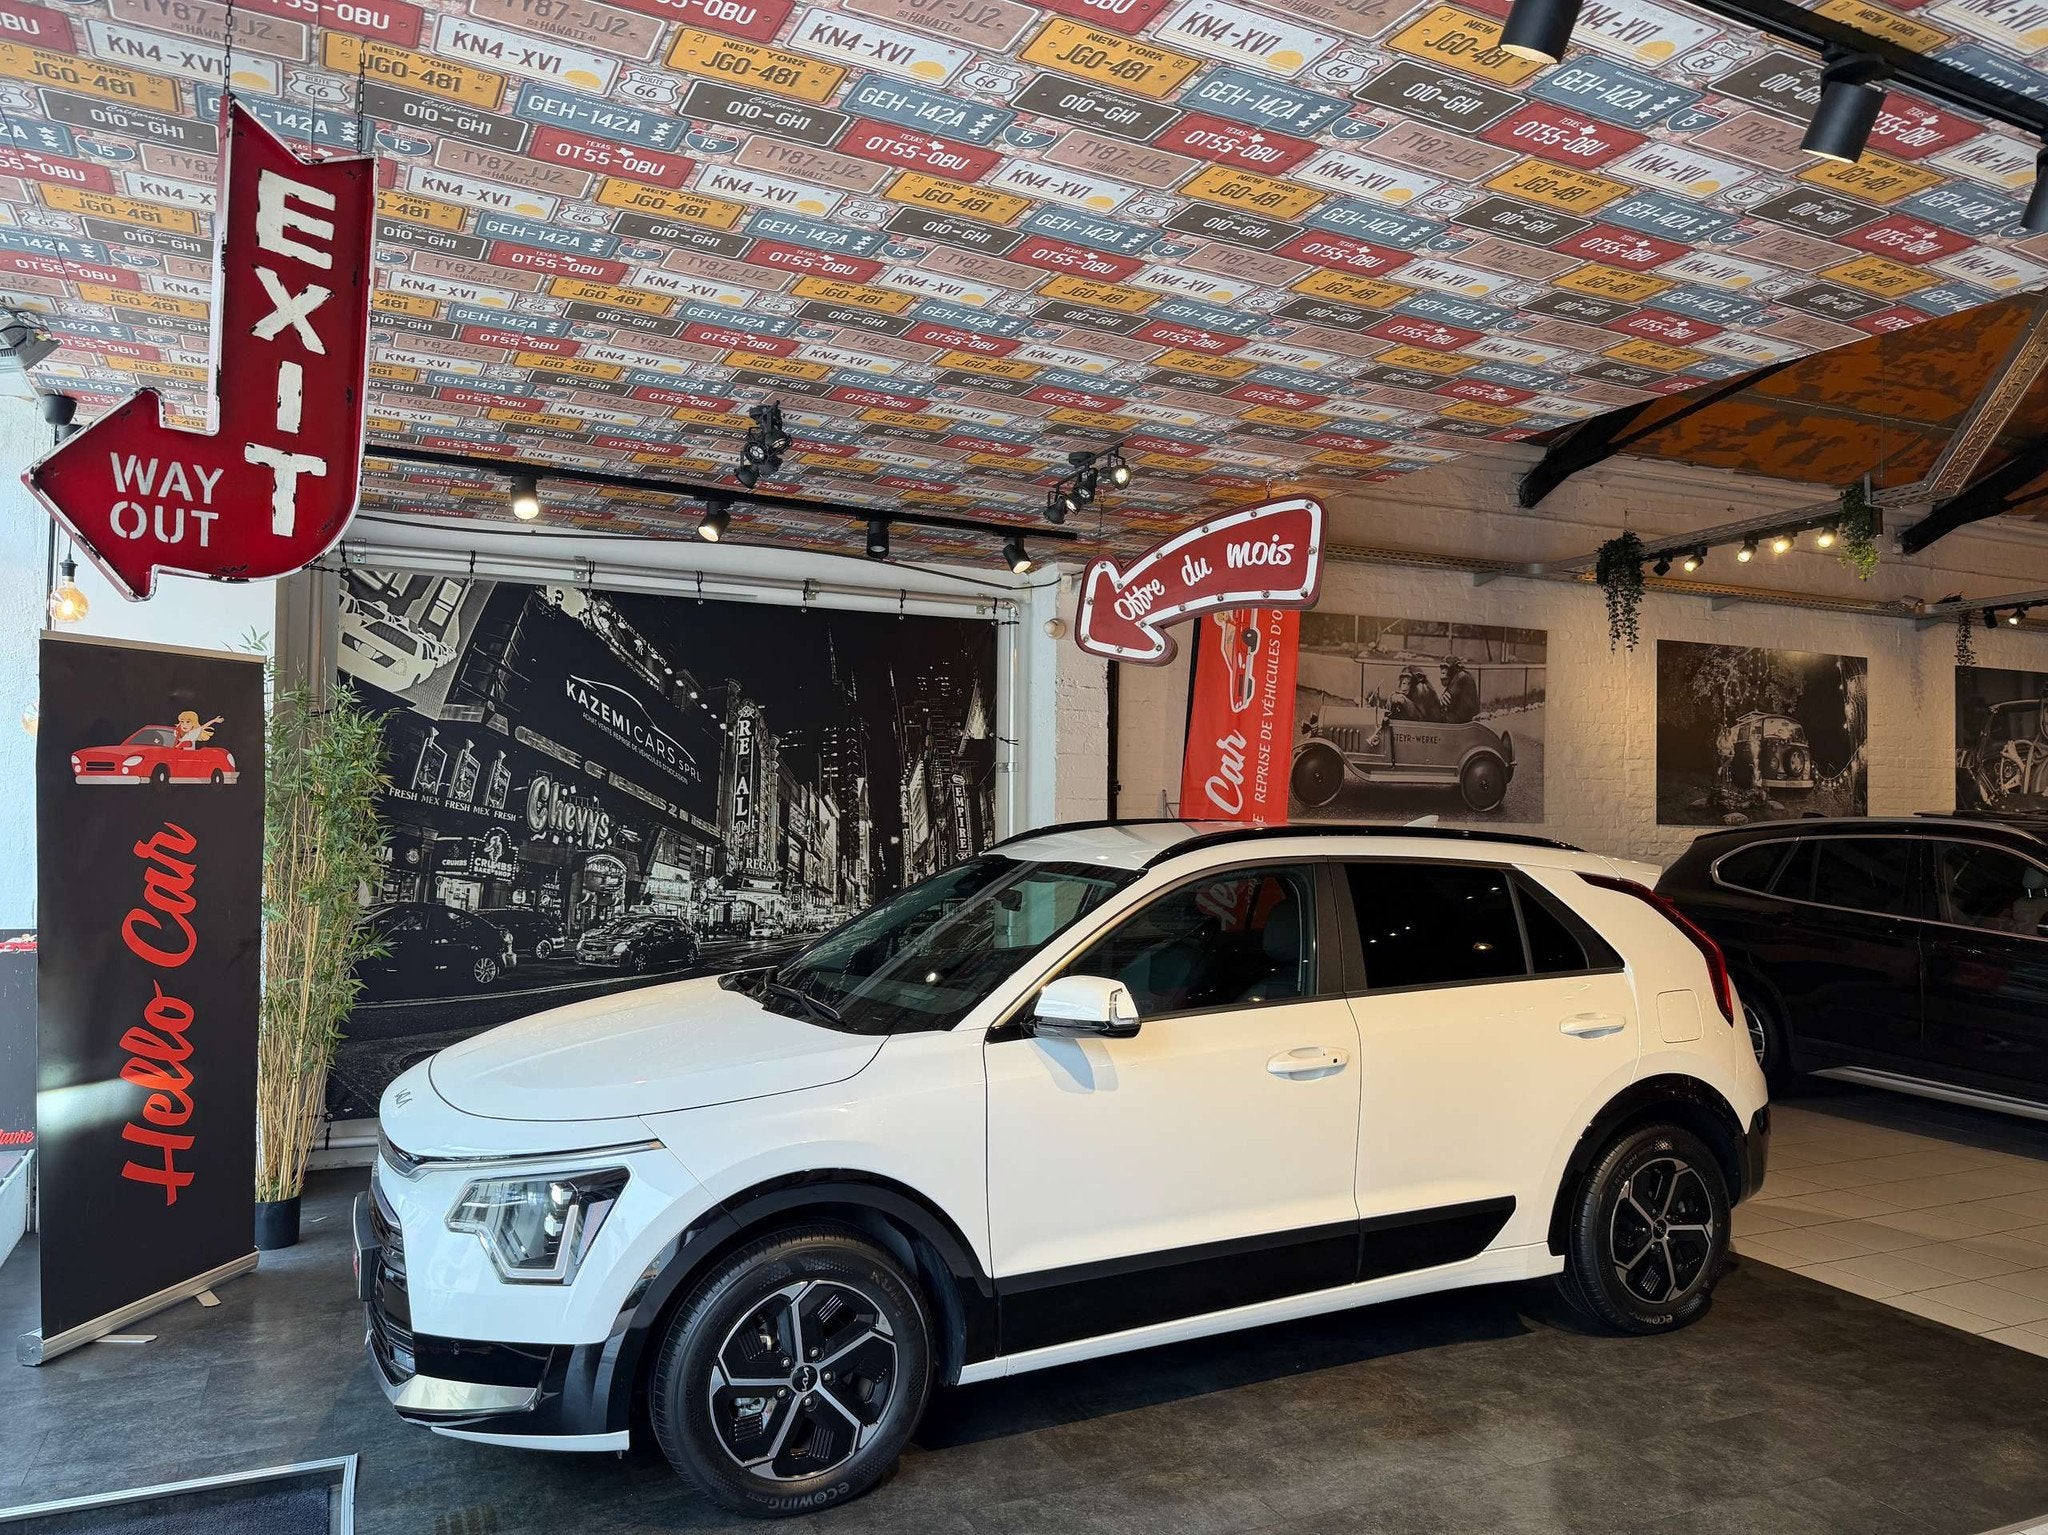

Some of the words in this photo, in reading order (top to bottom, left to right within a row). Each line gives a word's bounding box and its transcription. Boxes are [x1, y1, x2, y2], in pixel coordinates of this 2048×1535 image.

[1463, 19, 1499, 35] NEW
[1855, 9, 1887, 25] NEW
[1886, 17, 1922, 37] YORK
[371, 45, 409, 58] NEW
[418, 57, 463, 74] YORK
[720, 40, 761, 54] NEW
[762, 50, 811, 69] YORK
[1082, 32, 1125, 46] NEW
[1120, 42, 1169, 61] YORK
[30, 50, 71, 63] NEW
[79, 59, 132, 77] YORK
[1322, 64, 1359, 77] 66
[307, 88, 331, 100] 66
[633, 84, 661, 97] 66
[971, 75, 1003, 88] 66
[1552, 69, 1653, 110] GEH-142A
[858, 88, 966, 127] GEH-142A
[1199, 81, 1304, 119] GEH-142A
[528, 96, 640, 134] GEH-142A
[1337, 121, 1370, 134] 15
[1556, 118, 1585, 128] TEXAS
[700, 138, 719, 149] 15
[900, 134, 924, 143] TEXAS
[1012, 131, 1040, 143] 15
[1221, 126, 1250, 136] TEXAS
[95, 144, 115, 156] 15
[394, 139, 411, 151] 15
[586, 140, 611, 150] TEXAS
[1036, 214, 1123, 242] GEH-142A
[1322, 208, 1407, 236] GEH-142A
[1616, 202, 1699, 229] GEH-142A
[486, 221, 579, 247] GEH-142A
[757, 219, 848, 245] GEH-142A
[456, 310, 536, 329] GEH-142A
[687, 307, 765, 328] GEH-142A
[922, 306, 998, 328] GEH-142A
[1162, 304, 1236, 326] GEH-142A
[244, 169, 336, 538] EXIT
[110, 452, 224, 504] WAY
[110, 501, 219, 547] OUT
[1181, 554, 1213, 586] du
[1226, 533, 1295, 567] mois
[1262, 641, 1281, 717] VÉHICULES
[1261, 720, 1273, 740] DE
[678, 759, 702, 782] SPRL
[1204, 729, 1247, 815] Car
[1255, 747, 1271, 804] REPRISE
[388, 787, 418, 801] FRESH
[421, 794, 440, 806] MEX
[444, 799, 471, 813] FRESH
[473, 805, 490, 816] MEX
[493, 810, 517, 822] FRESH
[954, 786, 968, 850] EMPIRE
[474, 857, 513, 872] CRUMBS
[122, 821, 198, 968] Car
[119, 979, 195, 1206] Hello
